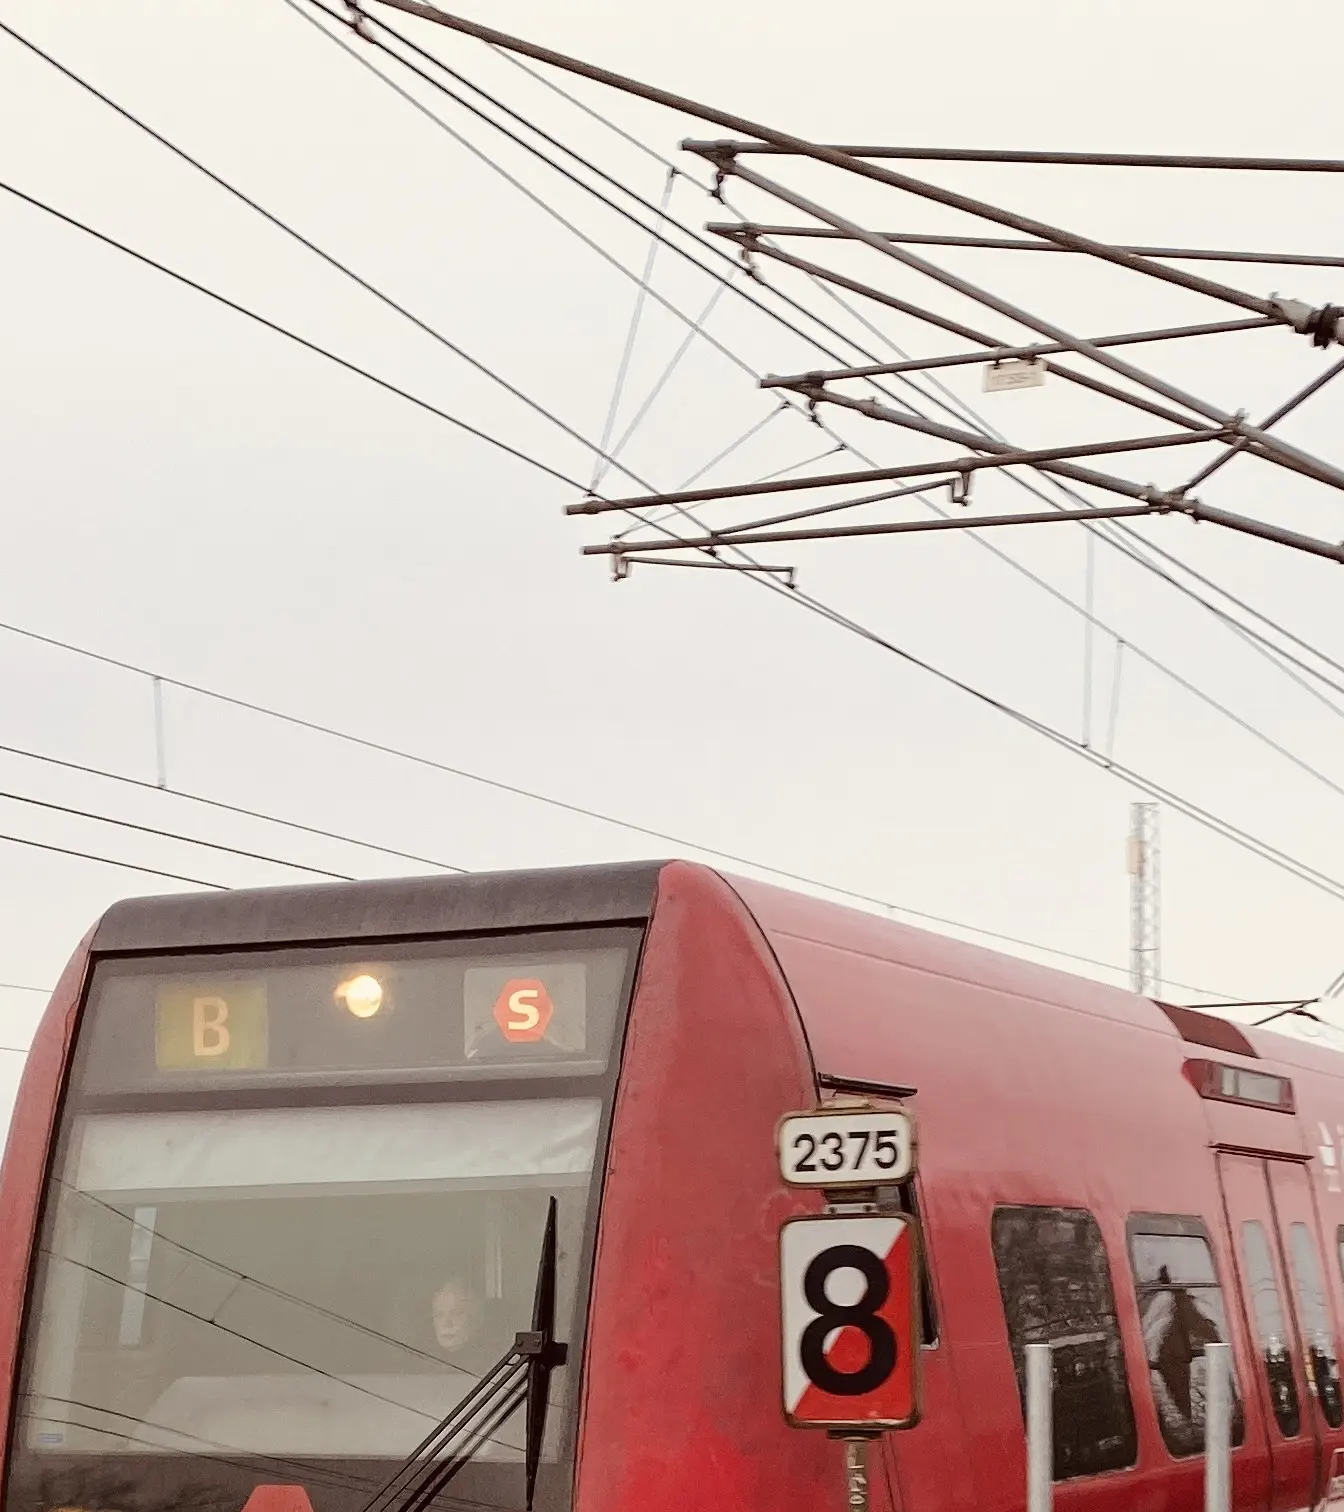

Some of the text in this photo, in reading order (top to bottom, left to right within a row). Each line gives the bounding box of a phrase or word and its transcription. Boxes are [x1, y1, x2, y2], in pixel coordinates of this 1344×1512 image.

[192, 995, 231, 1058] B
[506, 988, 541, 1031] S
[793, 1129, 899, 1173] 2375
[799, 1243, 898, 1397] 8
